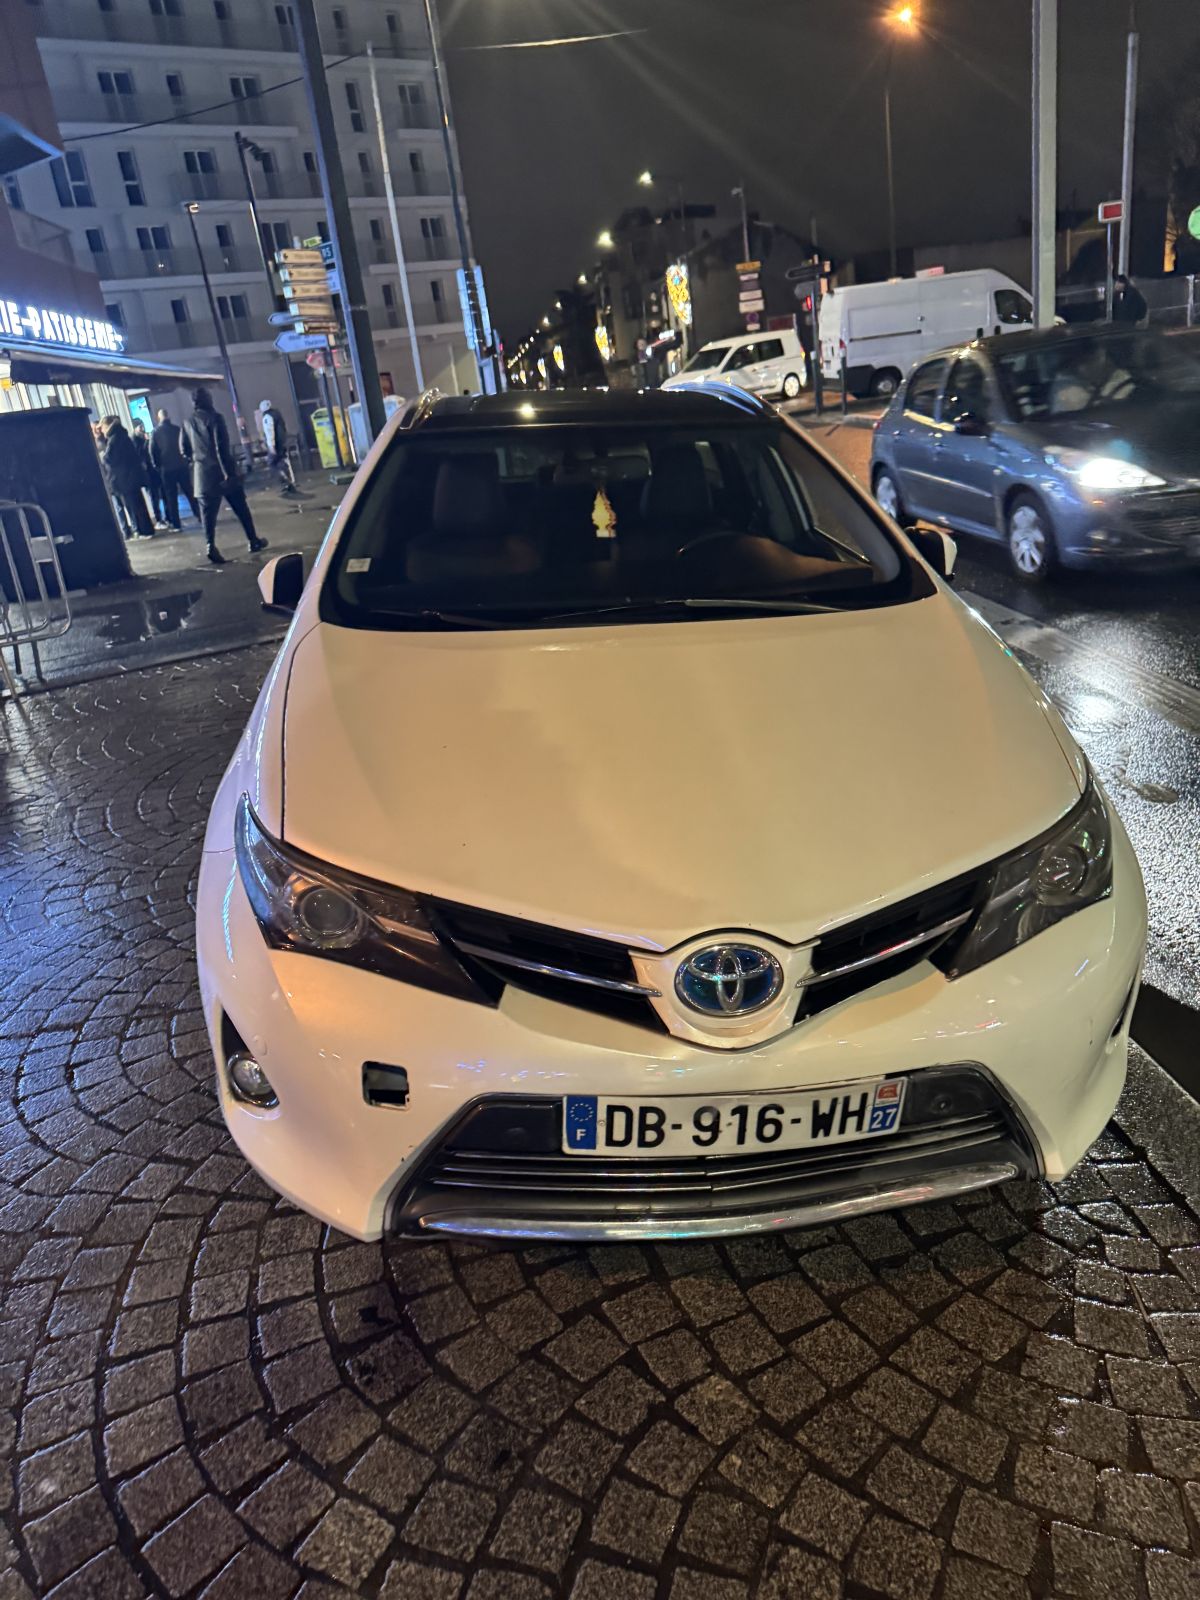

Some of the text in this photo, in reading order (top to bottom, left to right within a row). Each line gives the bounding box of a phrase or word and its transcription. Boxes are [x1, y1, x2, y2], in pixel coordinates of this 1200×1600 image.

[0, 300, 117, 351] IE-PATISSERIE
[576, 1129, 586, 1142] F
[605, 1092, 869, 1148] DB-916-WH
[871, 1108, 897, 1129] 27
